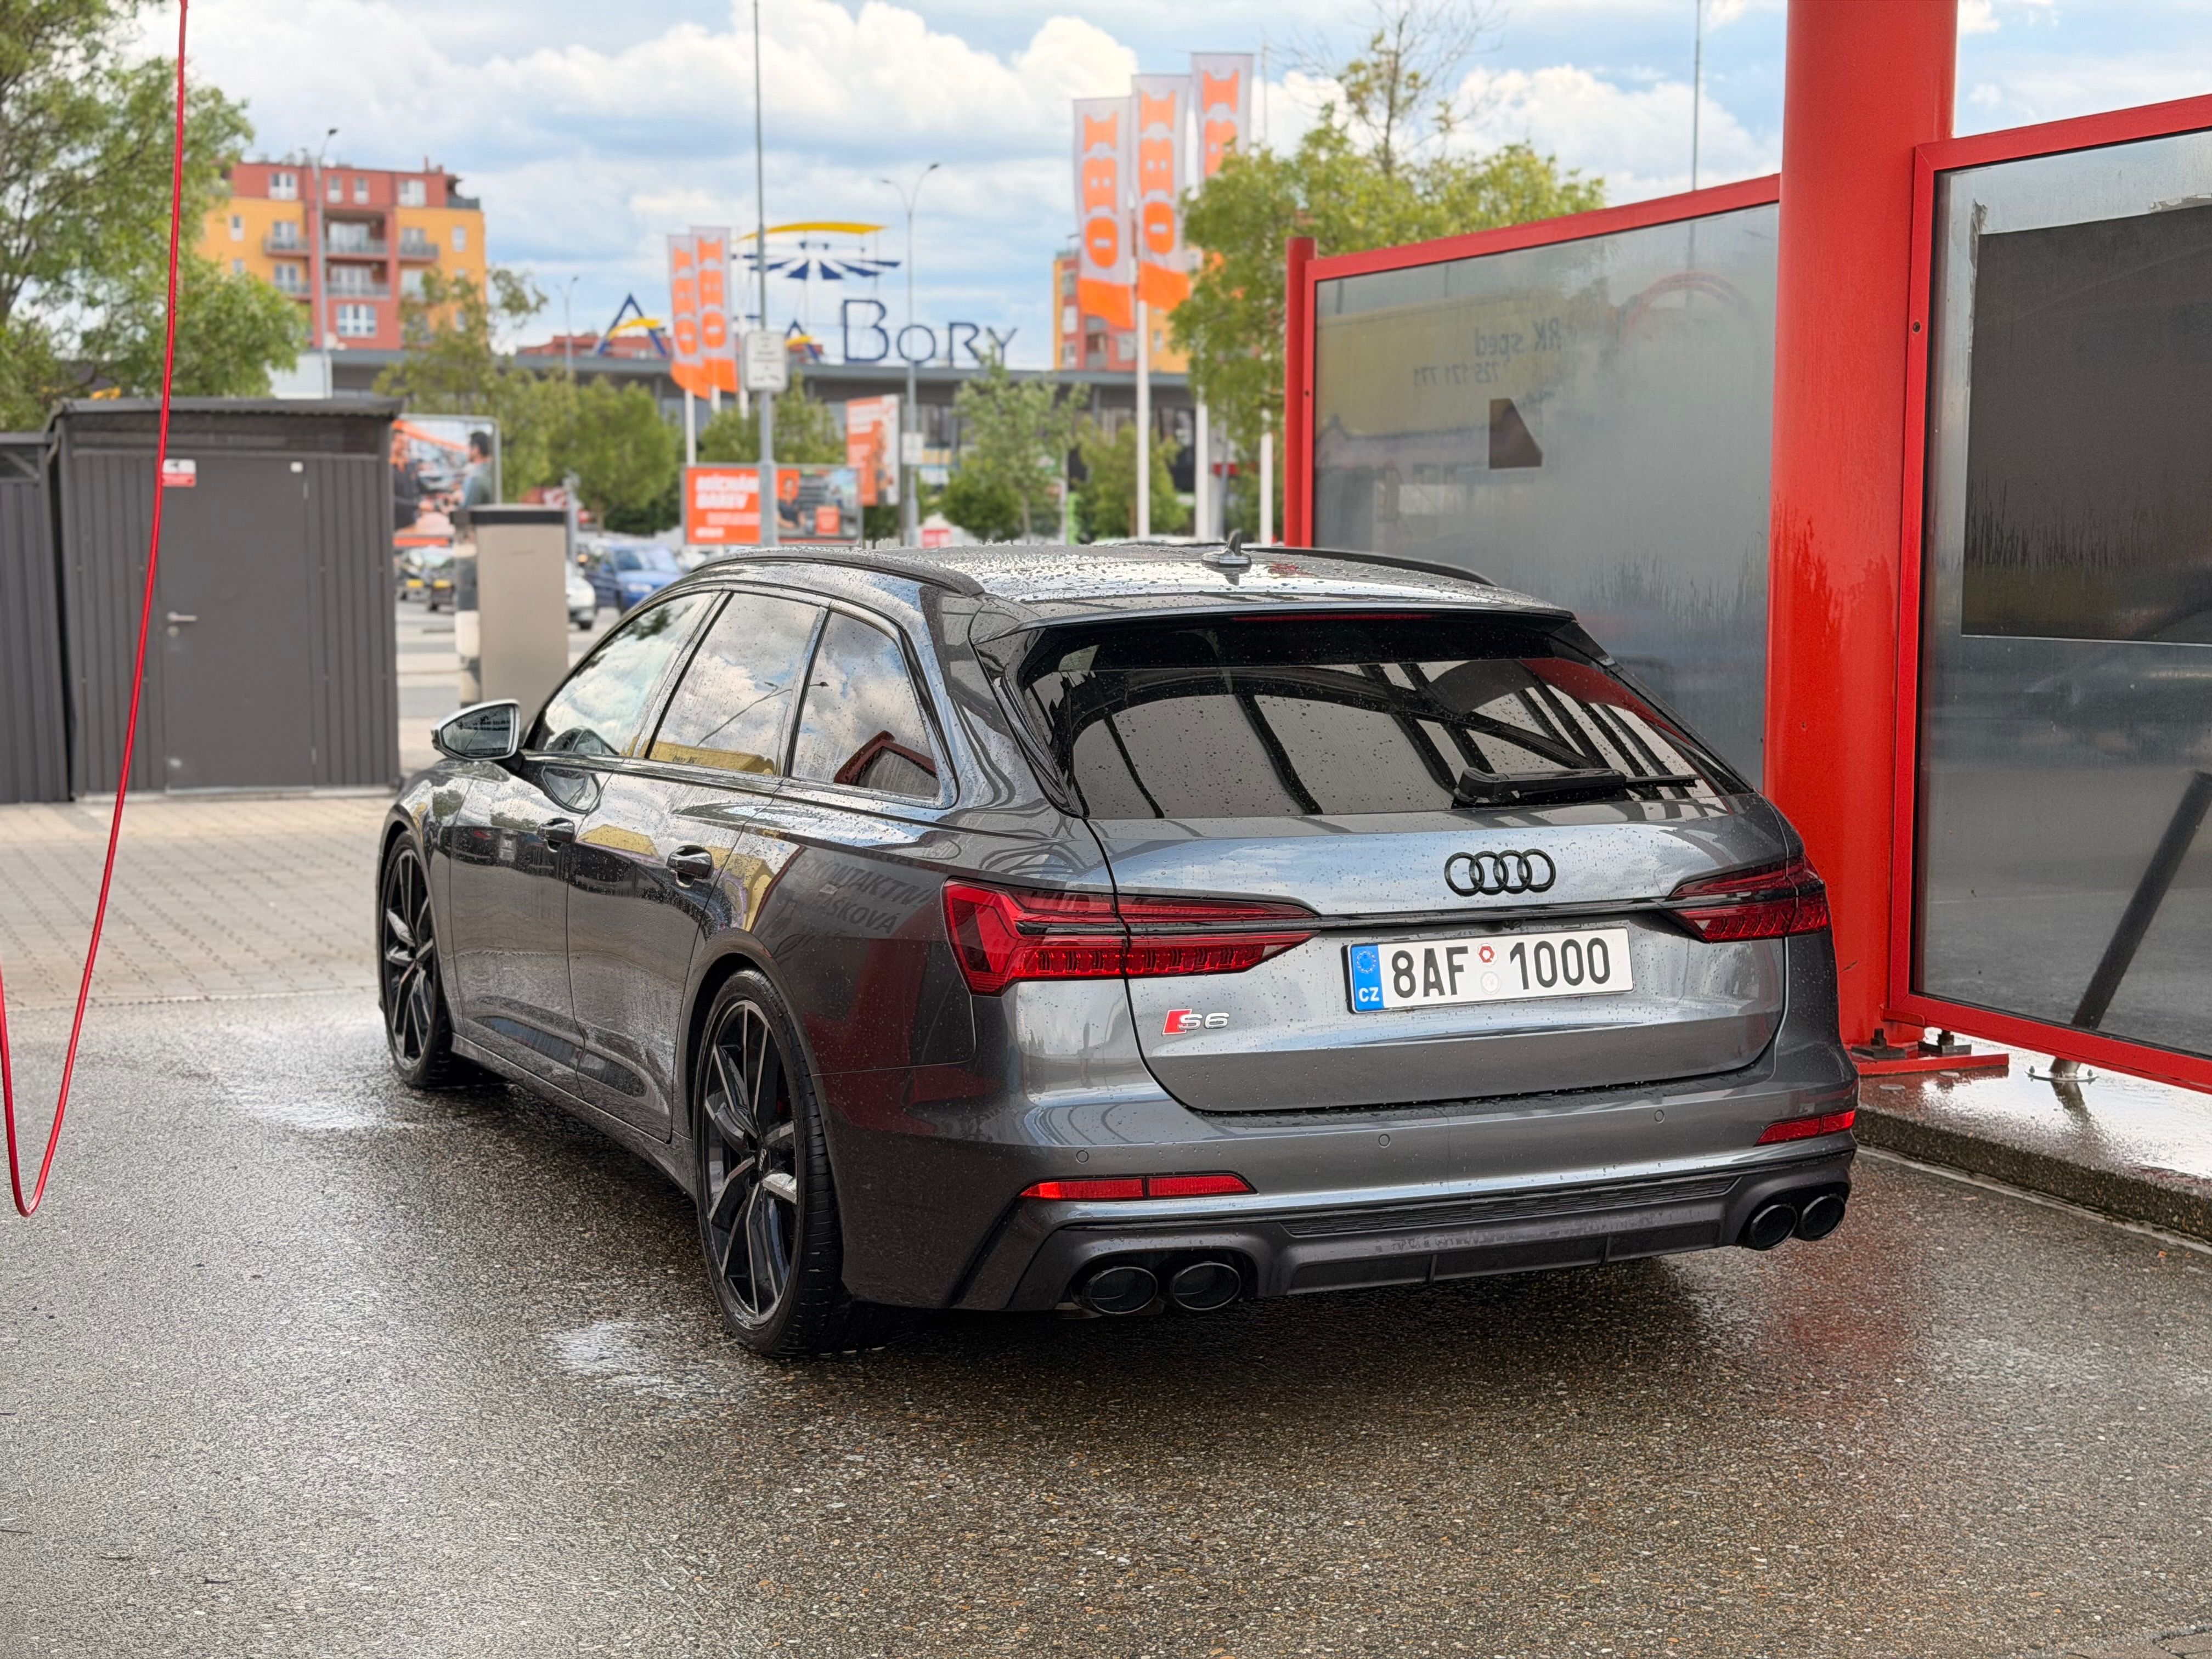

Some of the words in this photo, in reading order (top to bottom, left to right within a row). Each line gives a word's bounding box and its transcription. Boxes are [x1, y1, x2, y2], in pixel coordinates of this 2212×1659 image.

[1203, 70, 1239, 179] BI
[1083, 112, 1119, 267] OBI
[1139, 90, 1176, 255] OBI
[842, 300, 1018, 368] BORY
[1359, 986, 1380, 1003] CZ
[1391, 946, 1469, 999] 8AF
[1509, 937, 1611, 990] 1000
[1177, 1012, 1229, 1030] S6
